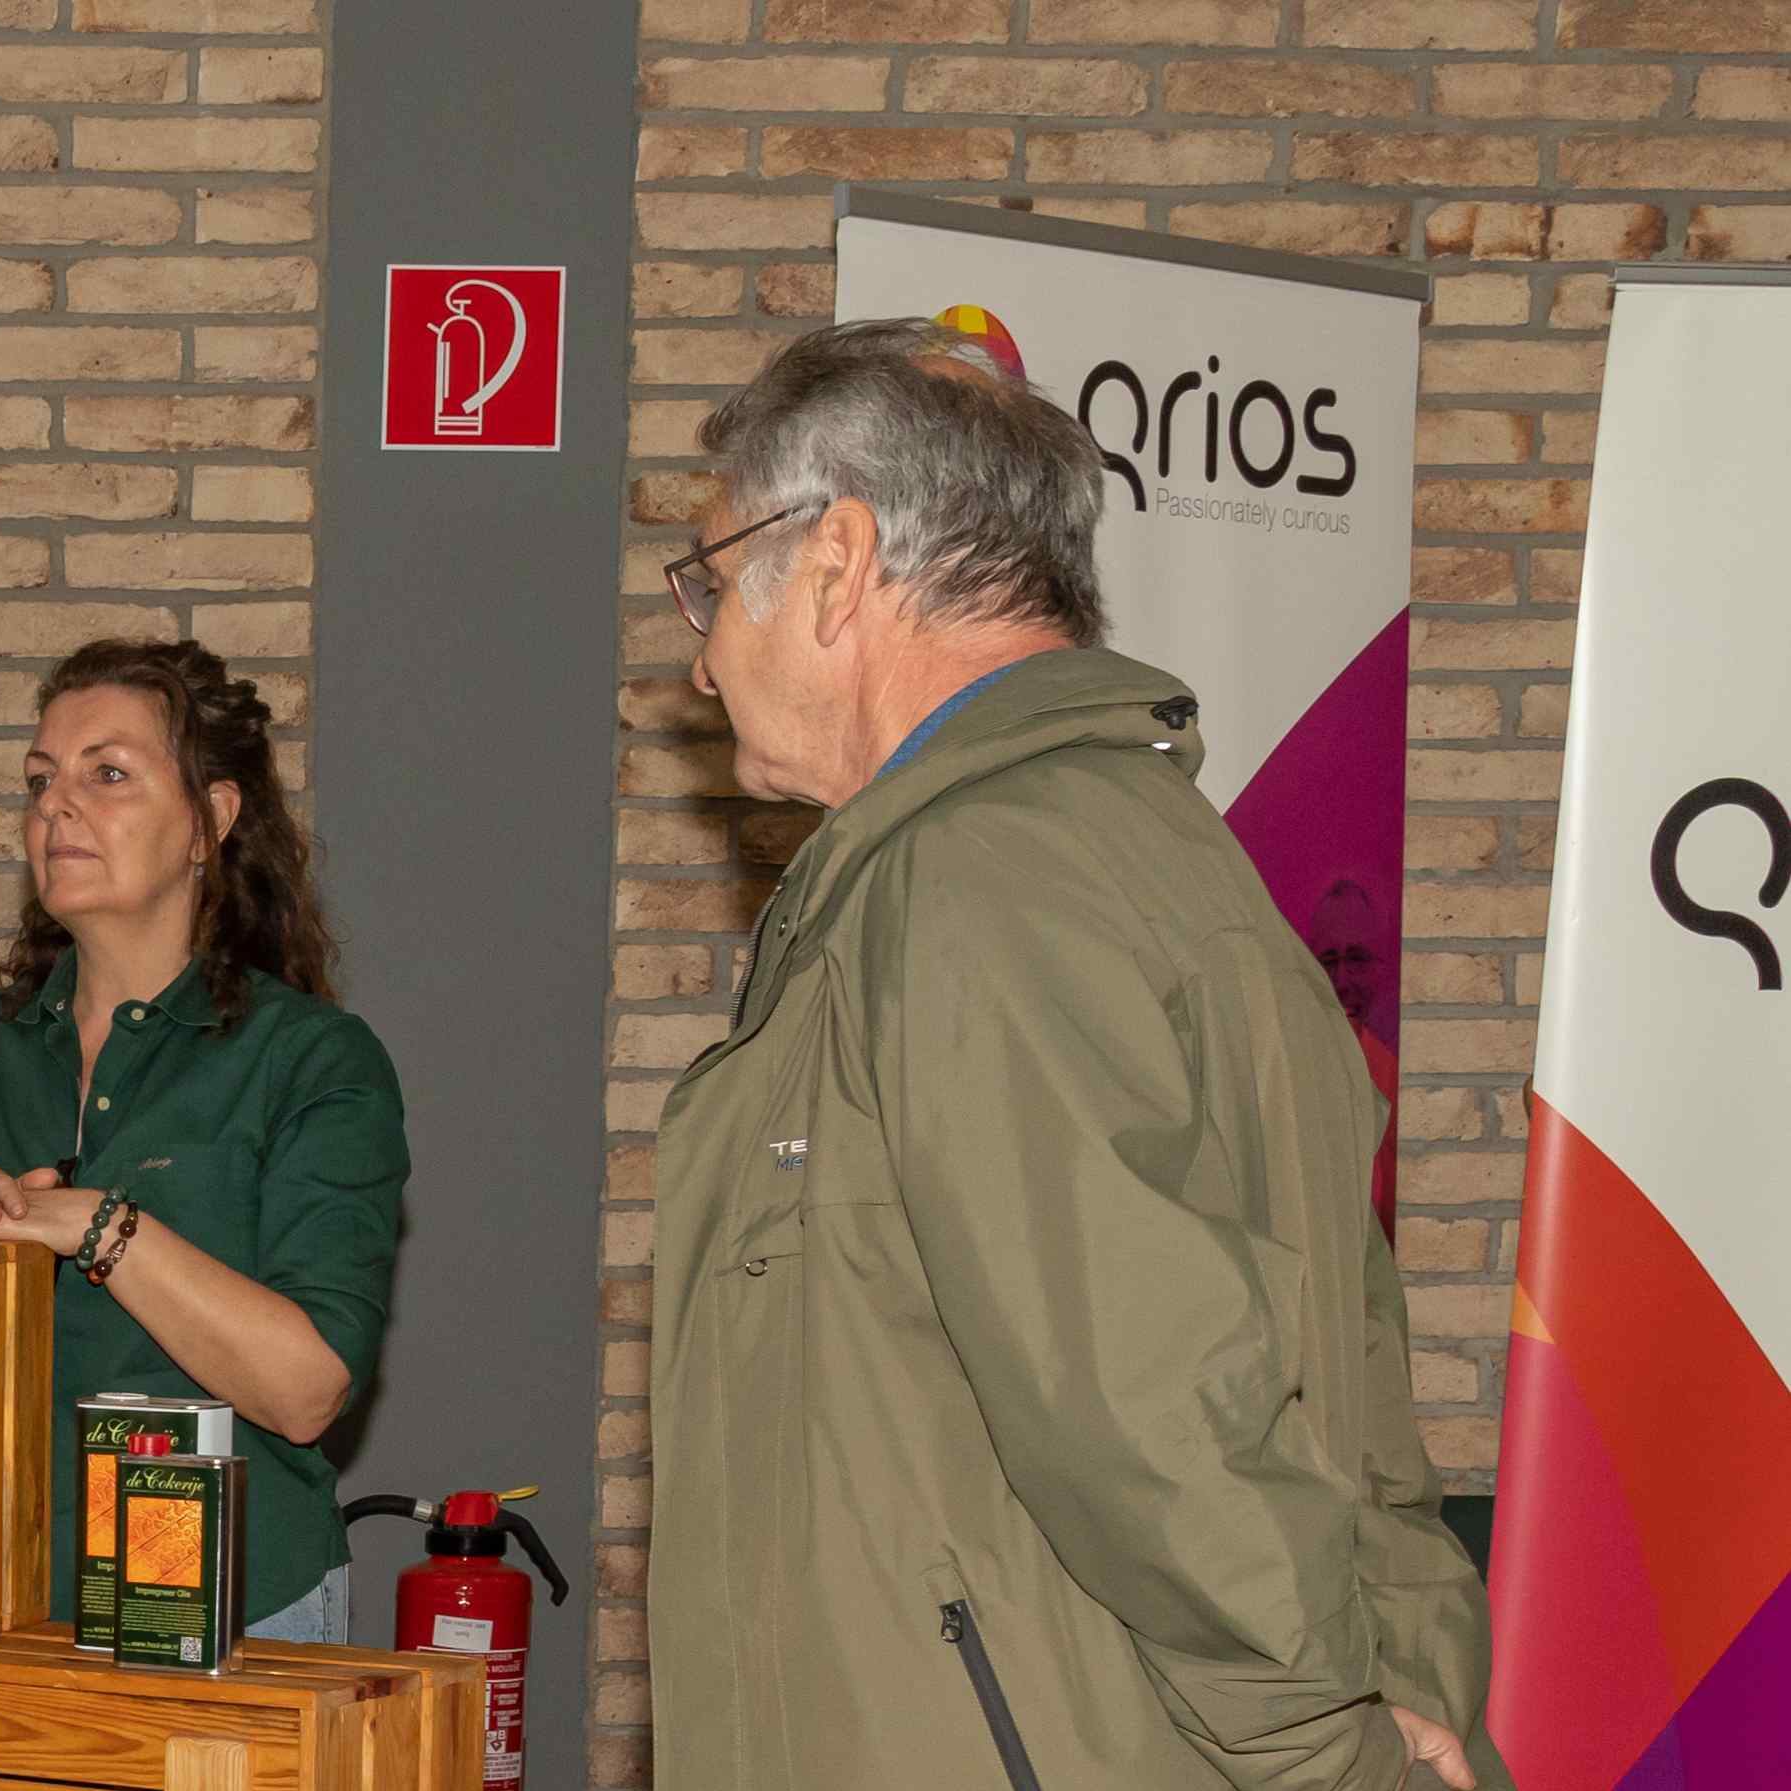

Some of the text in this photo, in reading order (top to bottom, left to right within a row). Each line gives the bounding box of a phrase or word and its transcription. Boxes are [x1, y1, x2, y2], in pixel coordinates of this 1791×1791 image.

[1155, 488, 1351, 534] Passionately curious
[769, 1139, 808, 1156] TE
[86, 1421, 107, 1443] de
[125, 1470, 143, 1488] de
